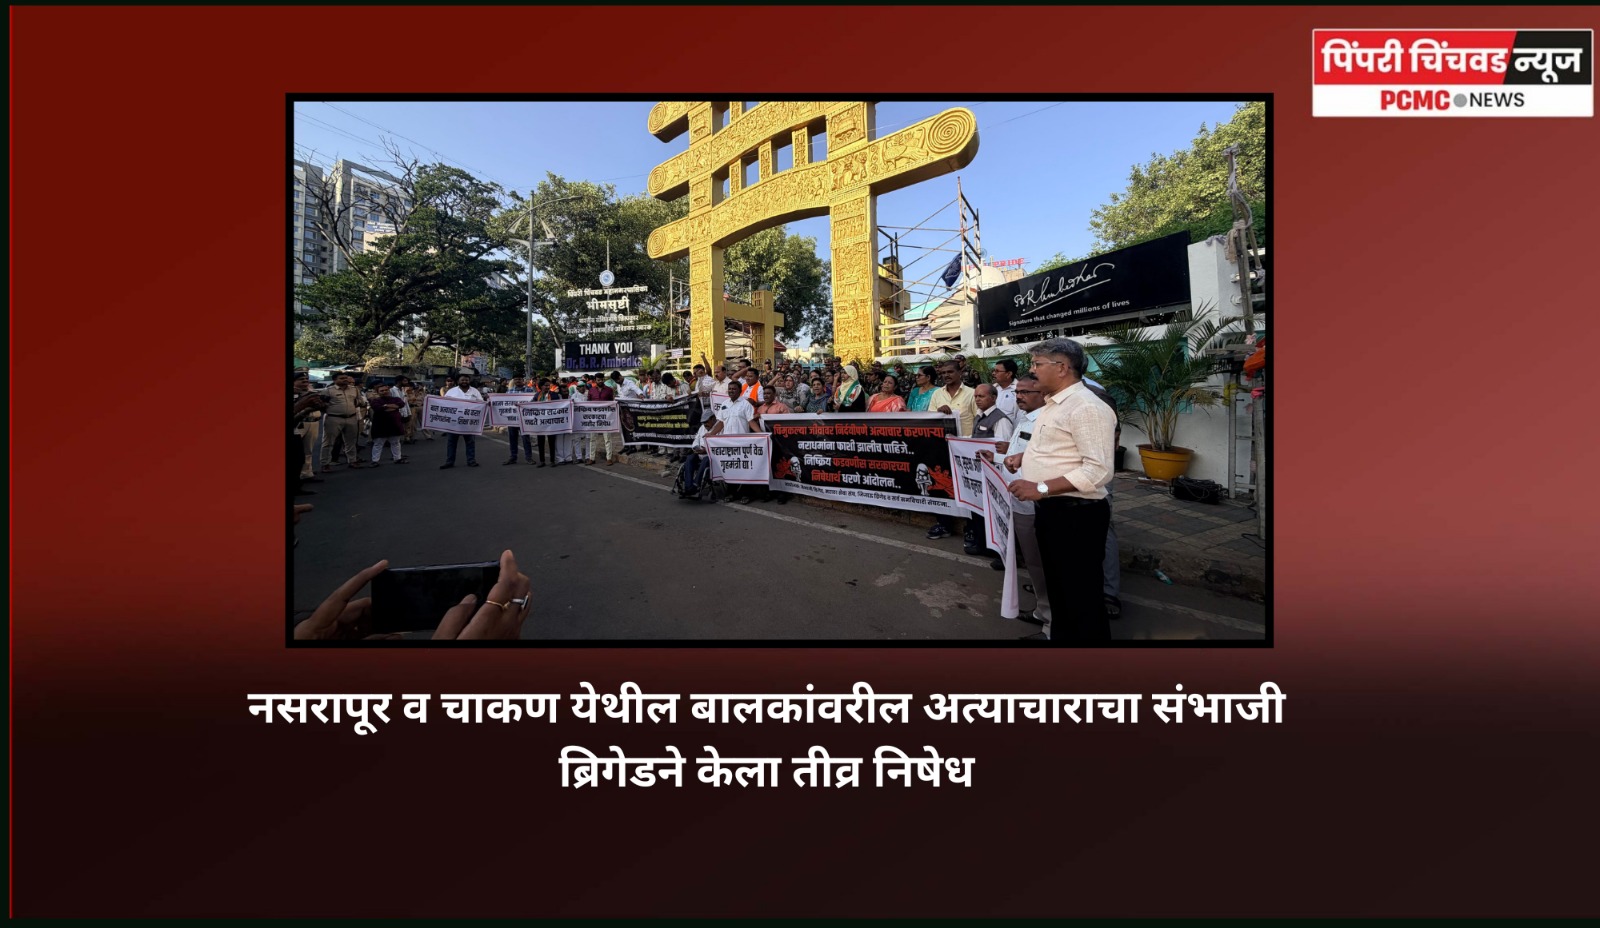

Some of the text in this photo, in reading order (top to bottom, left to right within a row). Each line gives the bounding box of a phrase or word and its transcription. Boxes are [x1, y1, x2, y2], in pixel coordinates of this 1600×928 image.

[586, 295, 629, 312] भीमसृष्टी
[1008, 317, 1033, 327] Signature
[1046, 310, 1072, 320] changed
[1073, 306, 1100, 315] millions
[1102, 301, 1110, 309] of
[1111, 300, 1130, 308] lives
[580, 342, 632, 355] THANK YOU
[566, 355, 642, 369] Dr. B. R. Ambedka
[773, 424, 807, 438] चिमुकल्या
[835, 423, 868, 436] निर्दयीपणे
[870, 426, 902, 437] अत्याचार
[903, 427, 944, 438] करणाऱ्या
[710, 444, 764, 459] महाराष्ट्राला पूर्ण वेळ
[797, 439, 836, 451] नराधमांना
[836, 439, 856, 452] फाशी
[856, 440, 882, 453] झालीच
[720, 458, 741, 473] गृहमंत्री
[803, 454, 832, 466] निष्क्रिय
[868, 460, 910, 472] सरकारच्या
[811, 469, 841, 482] निषेधार्थ
[842, 472, 861, 485] धरणे
